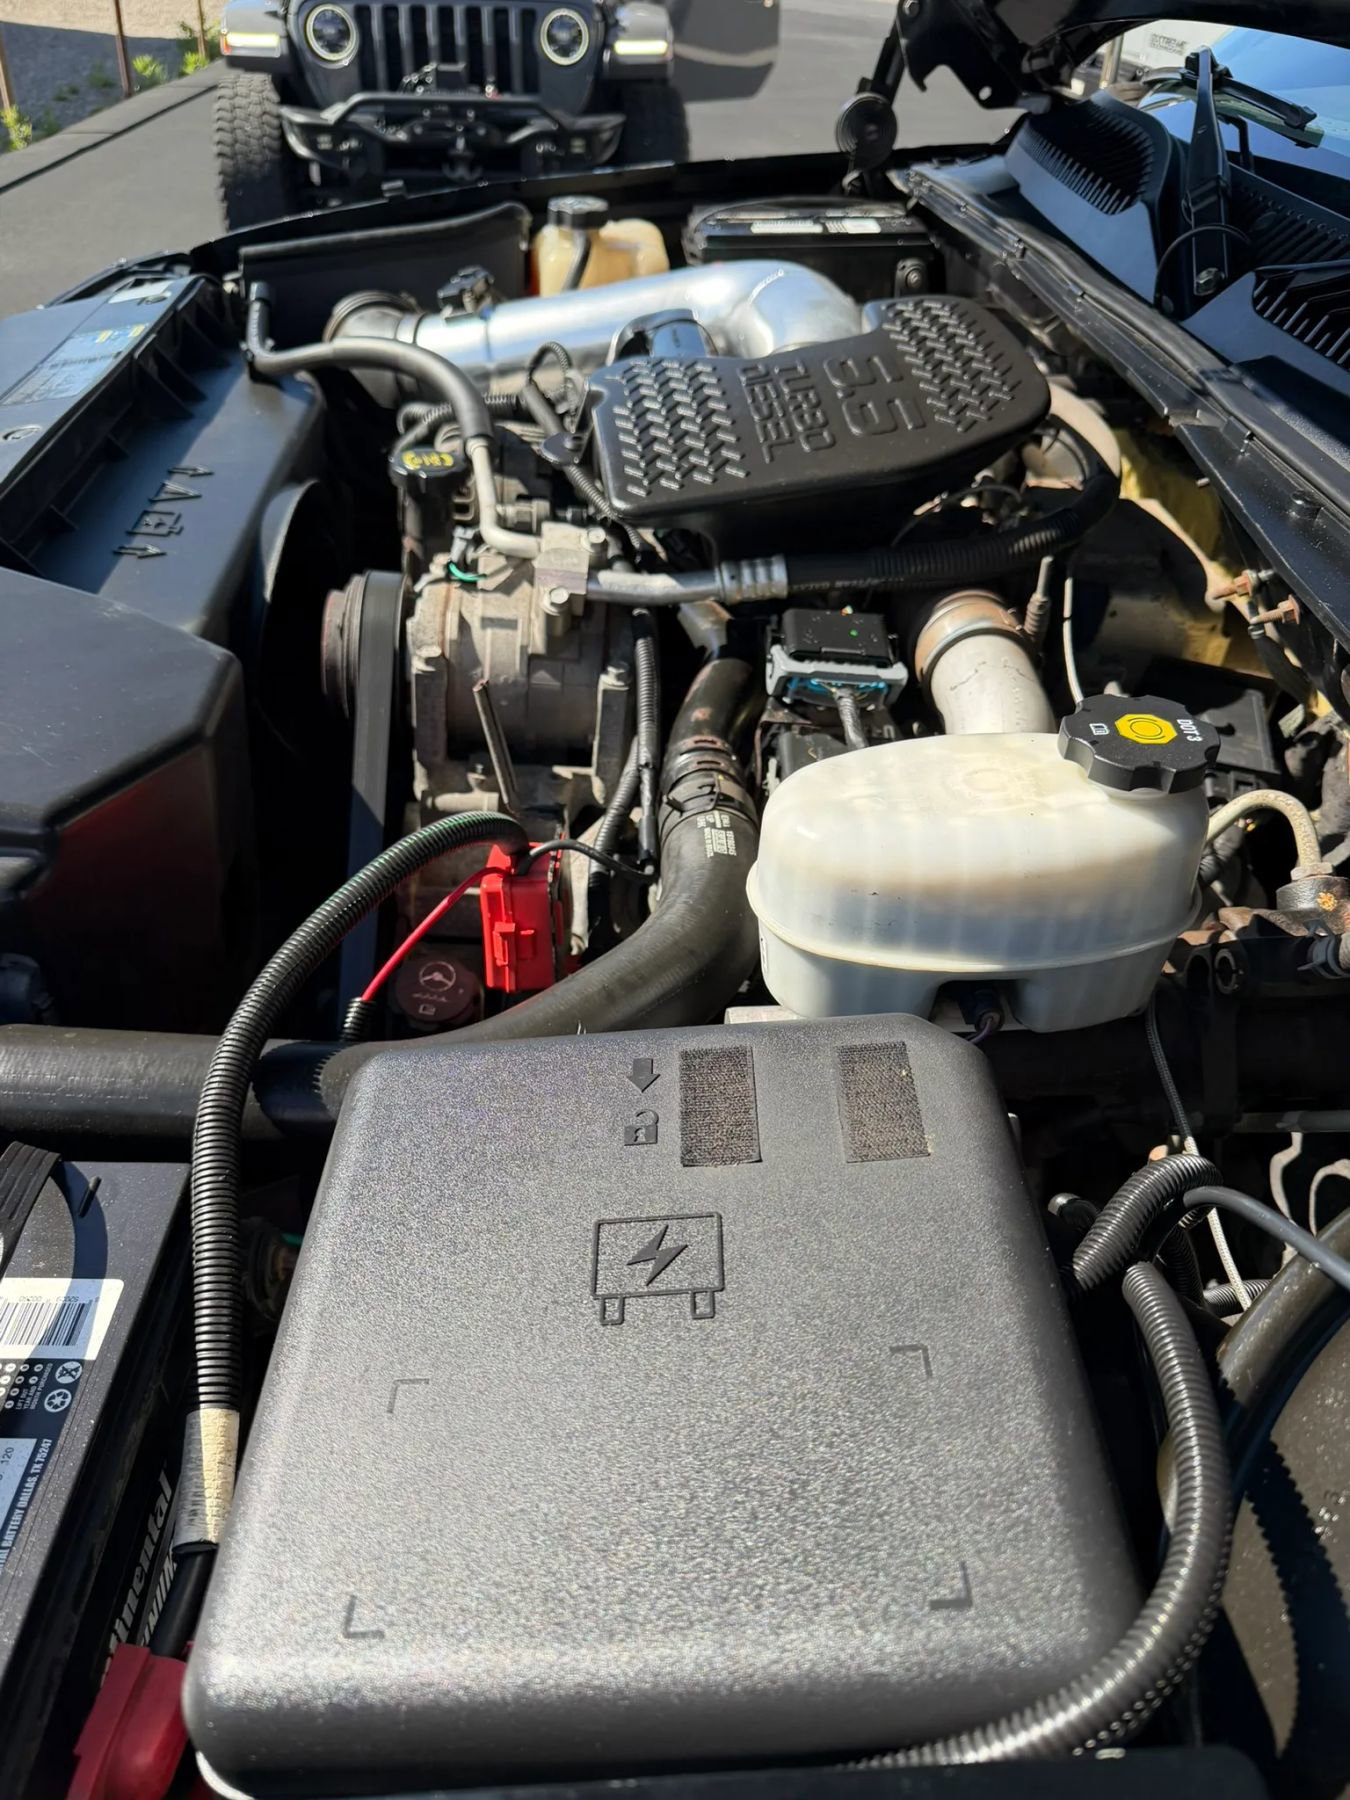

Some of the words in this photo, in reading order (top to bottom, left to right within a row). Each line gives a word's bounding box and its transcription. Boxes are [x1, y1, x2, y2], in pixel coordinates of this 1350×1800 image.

[735, 363, 795, 464] DIESEL
[773, 360, 838, 452] TURBO
[1176, 719, 1200, 736] DOT
[1, 1509, 25, 1548] BATTERY
